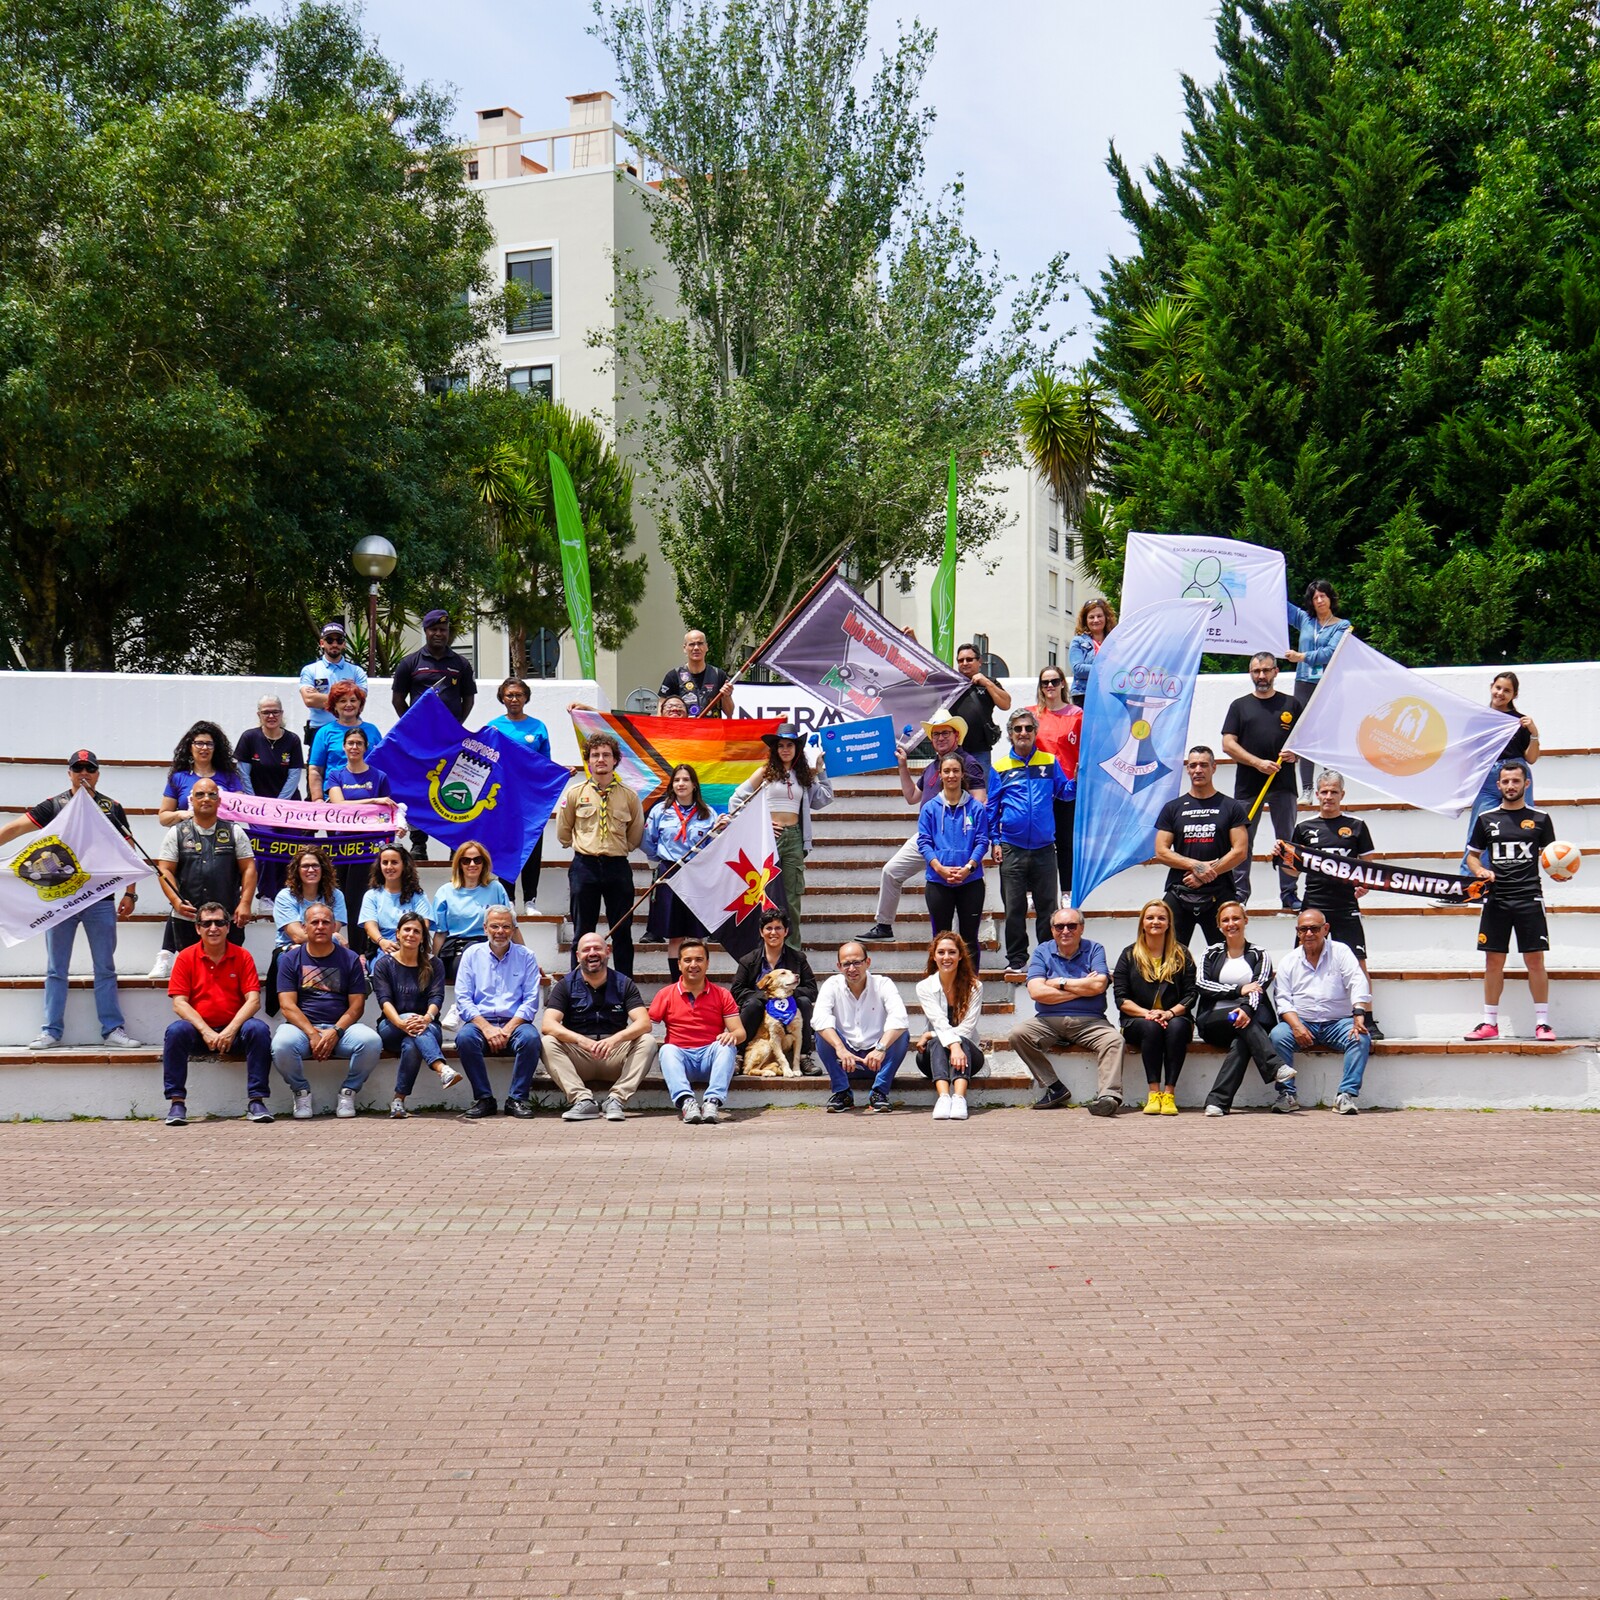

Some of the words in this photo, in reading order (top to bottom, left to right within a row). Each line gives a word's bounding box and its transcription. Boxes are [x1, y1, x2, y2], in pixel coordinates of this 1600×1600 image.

[842, 611, 866, 642] Moto
[863, 629, 888, 658] Clube
[1207, 627, 1222, 637] EE
[1118, 671, 1177, 694] JOMA
[227, 799, 267, 817] Real
[273, 804, 318, 824] Sport
[325, 808, 369, 825] Clube
[1181, 808, 1220, 816] INSTRUTOR
[1183, 823, 1216, 832] HIGGS
[250, 840, 265, 852] AL
[1492, 842, 1533, 859] LTX
[1300, 851, 1385, 886] TEQBALL
[1390, 872, 1464, 896] SINTRA
